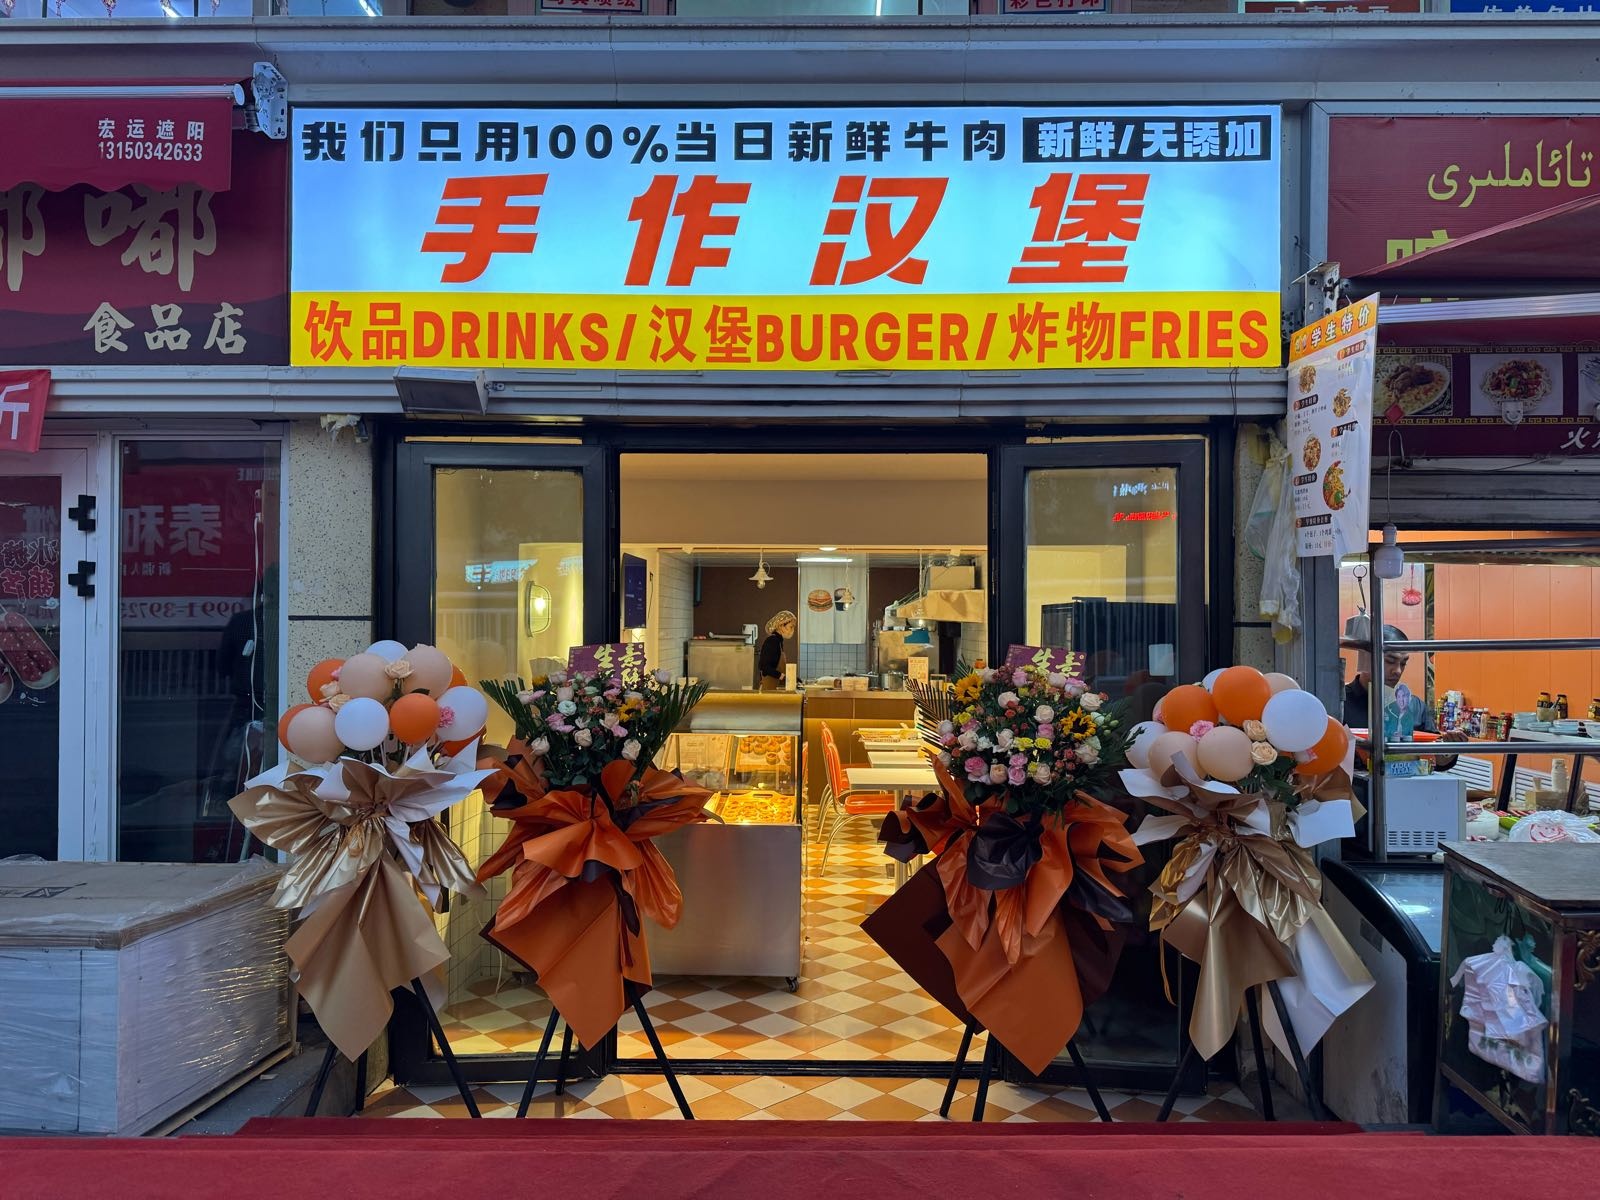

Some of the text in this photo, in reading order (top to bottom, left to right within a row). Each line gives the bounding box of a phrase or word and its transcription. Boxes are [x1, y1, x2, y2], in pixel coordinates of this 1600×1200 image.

[98, 118, 205, 140] 宏运遮阳
[302, 120, 1263, 164] 我们只用100%当日新鲜牛肉 新鲜/无添加
[98, 141, 203, 162] 13150342633
[420, 172, 1151, 287] 手作汉堡
[83, 302, 248, 355] 食品店
[1311, 304, 1370, 348] 学生特价
[593, 643, 642, 669] 生意
